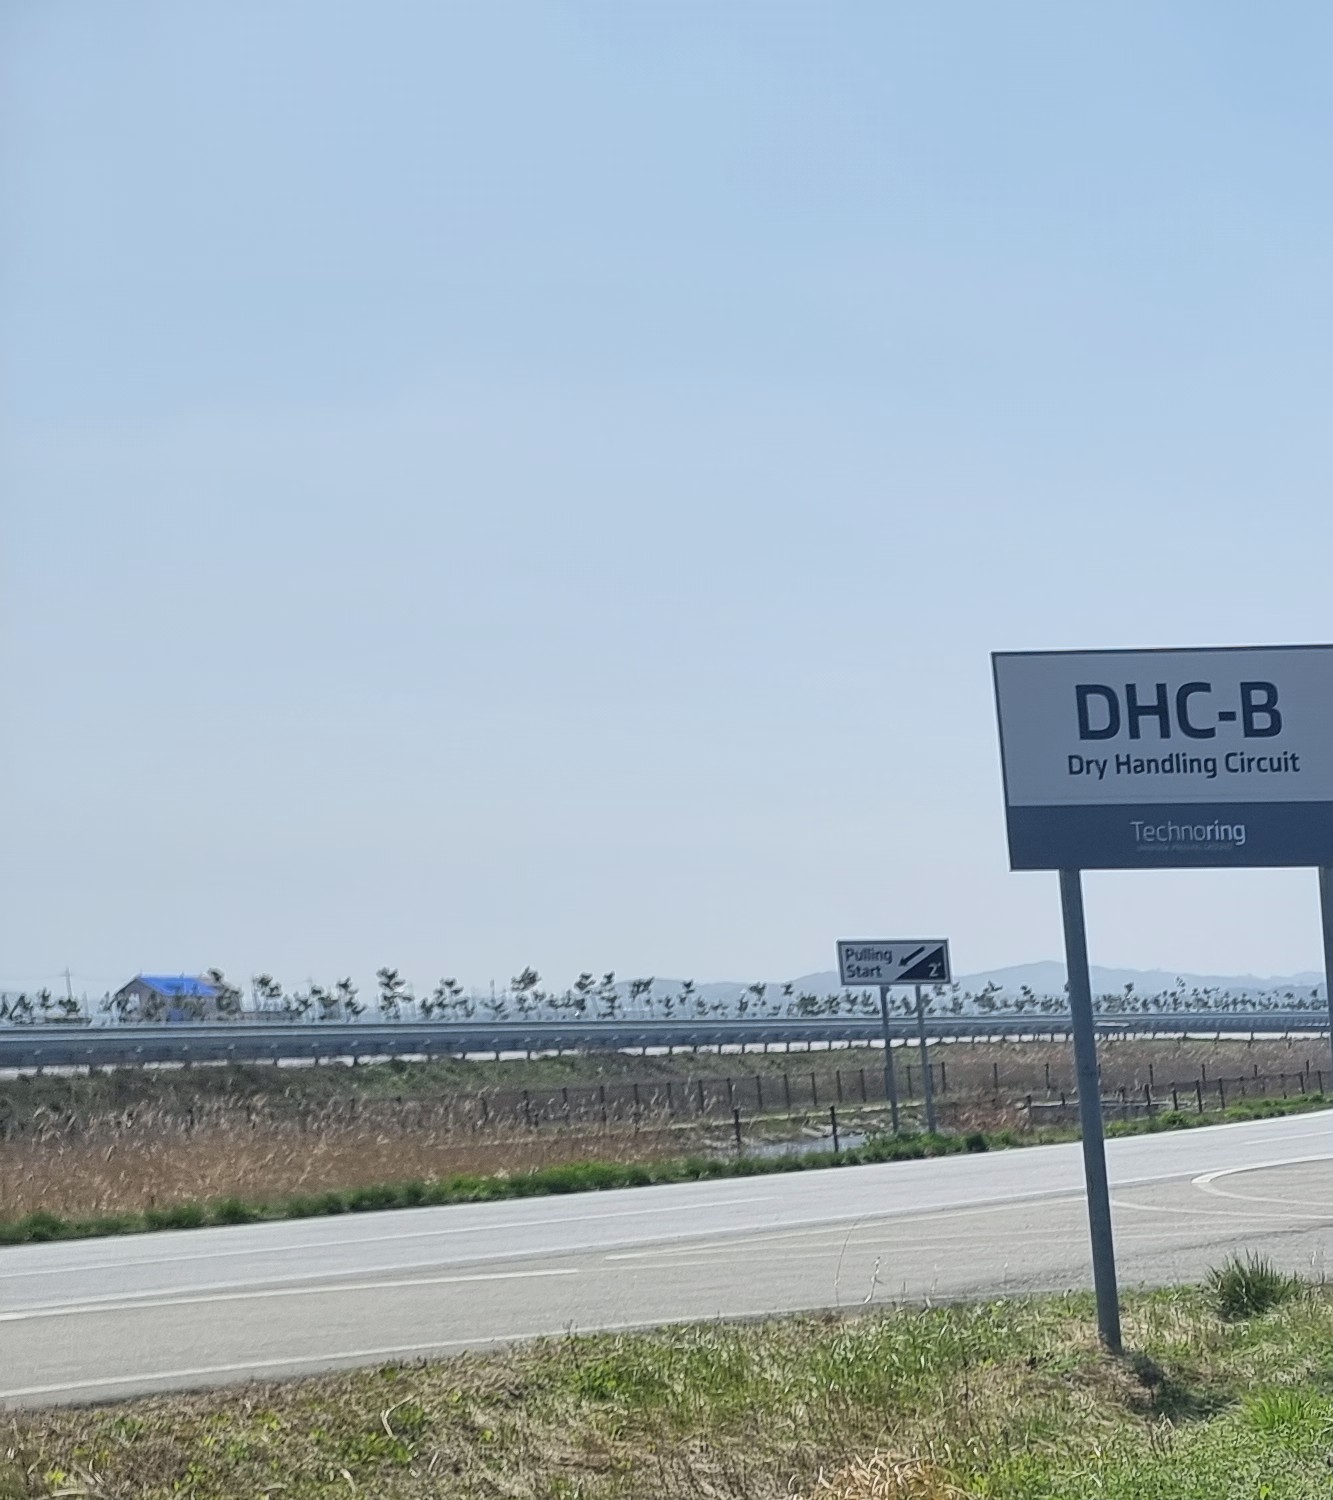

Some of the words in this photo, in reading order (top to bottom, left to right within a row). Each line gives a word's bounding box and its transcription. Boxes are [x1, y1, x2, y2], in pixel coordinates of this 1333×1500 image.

[1075, 682, 1282, 740] DHC-B
[1068, 754, 1107, 779] Dry
[1115, 752, 1217, 778] Handling
[1225, 750, 1300, 773] Circuit
[1130, 819, 1246, 846] Technoring
[845, 948, 893, 965] Pulling
[847, 964, 882, 978] Start
